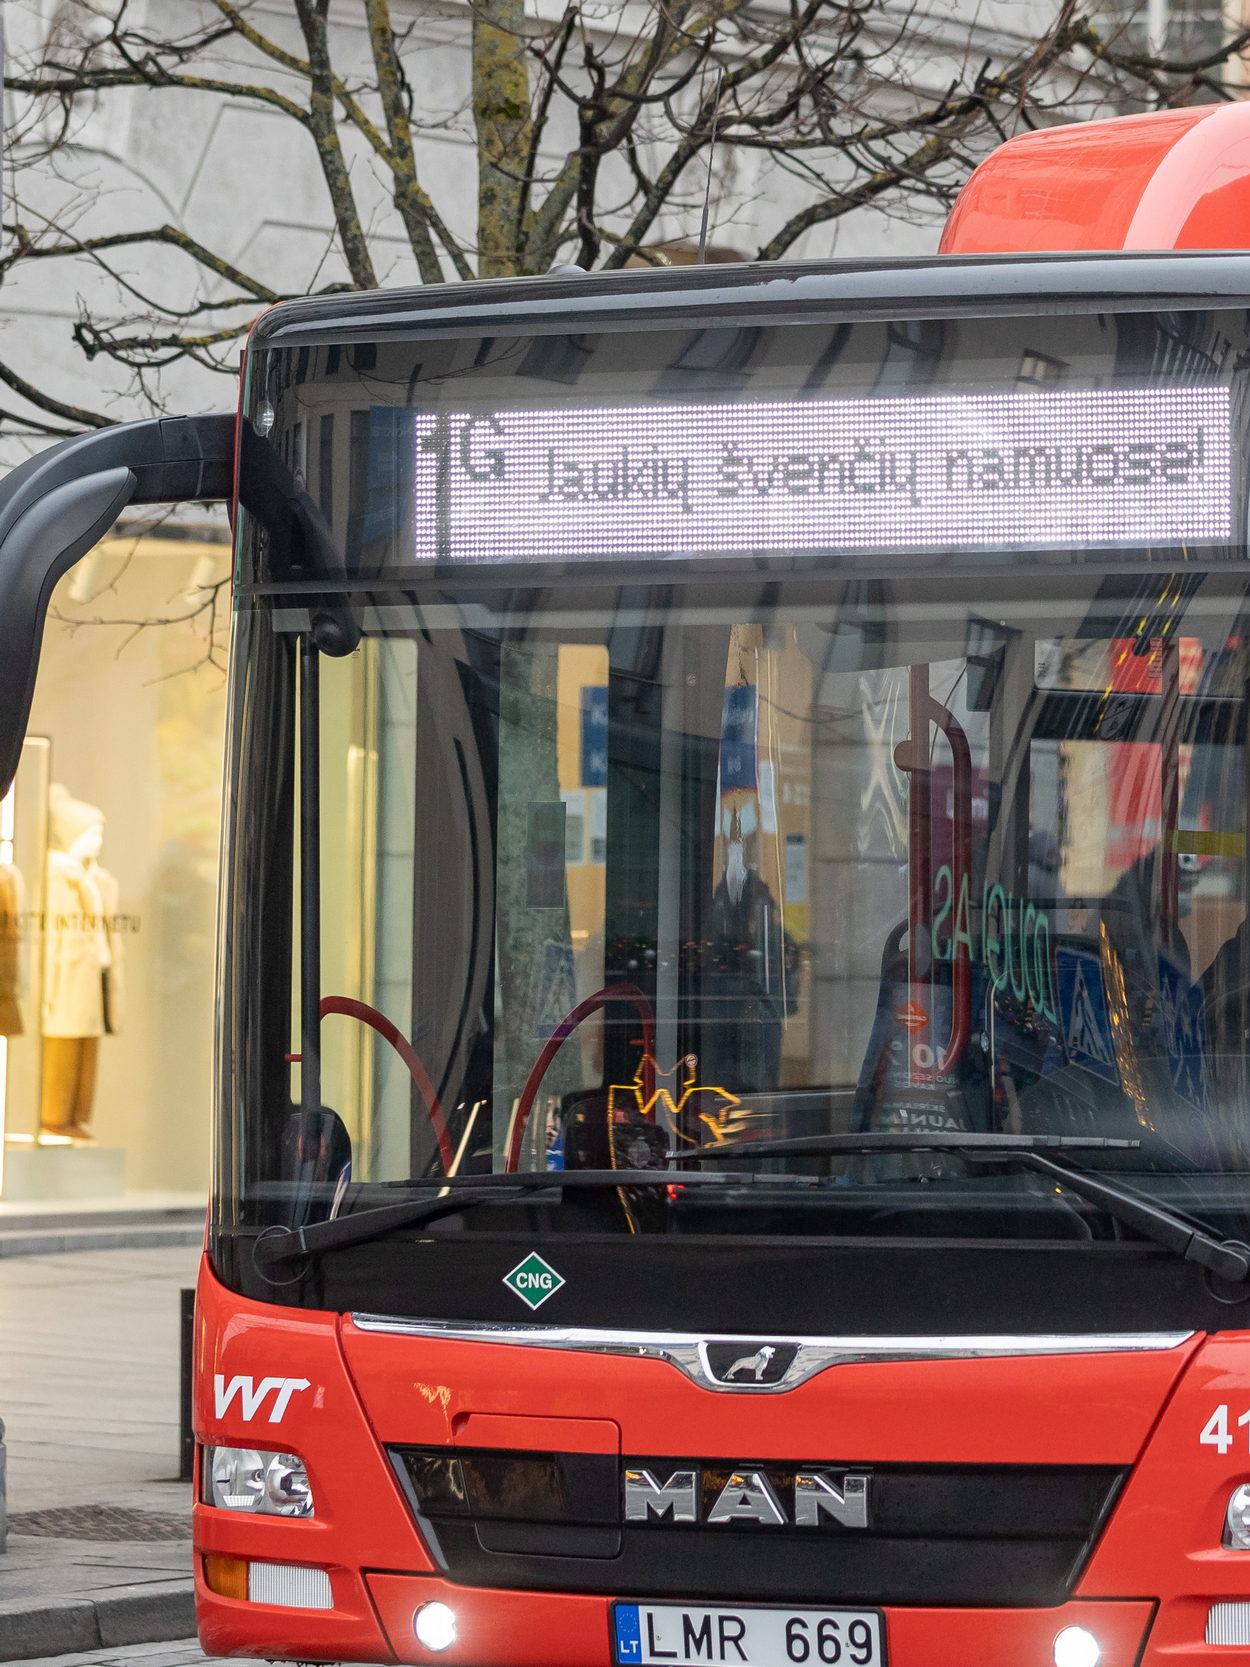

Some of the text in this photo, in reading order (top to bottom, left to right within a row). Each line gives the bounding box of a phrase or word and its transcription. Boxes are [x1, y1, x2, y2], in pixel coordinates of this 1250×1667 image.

[945, 427, 1205, 491] namuose!
[515, 1271, 553, 1291] CNG
[624, 1466, 871, 1528] MAN
[620, 1640, 639, 1654] LT
[646, 1612, 873, 1665] LMR 669
